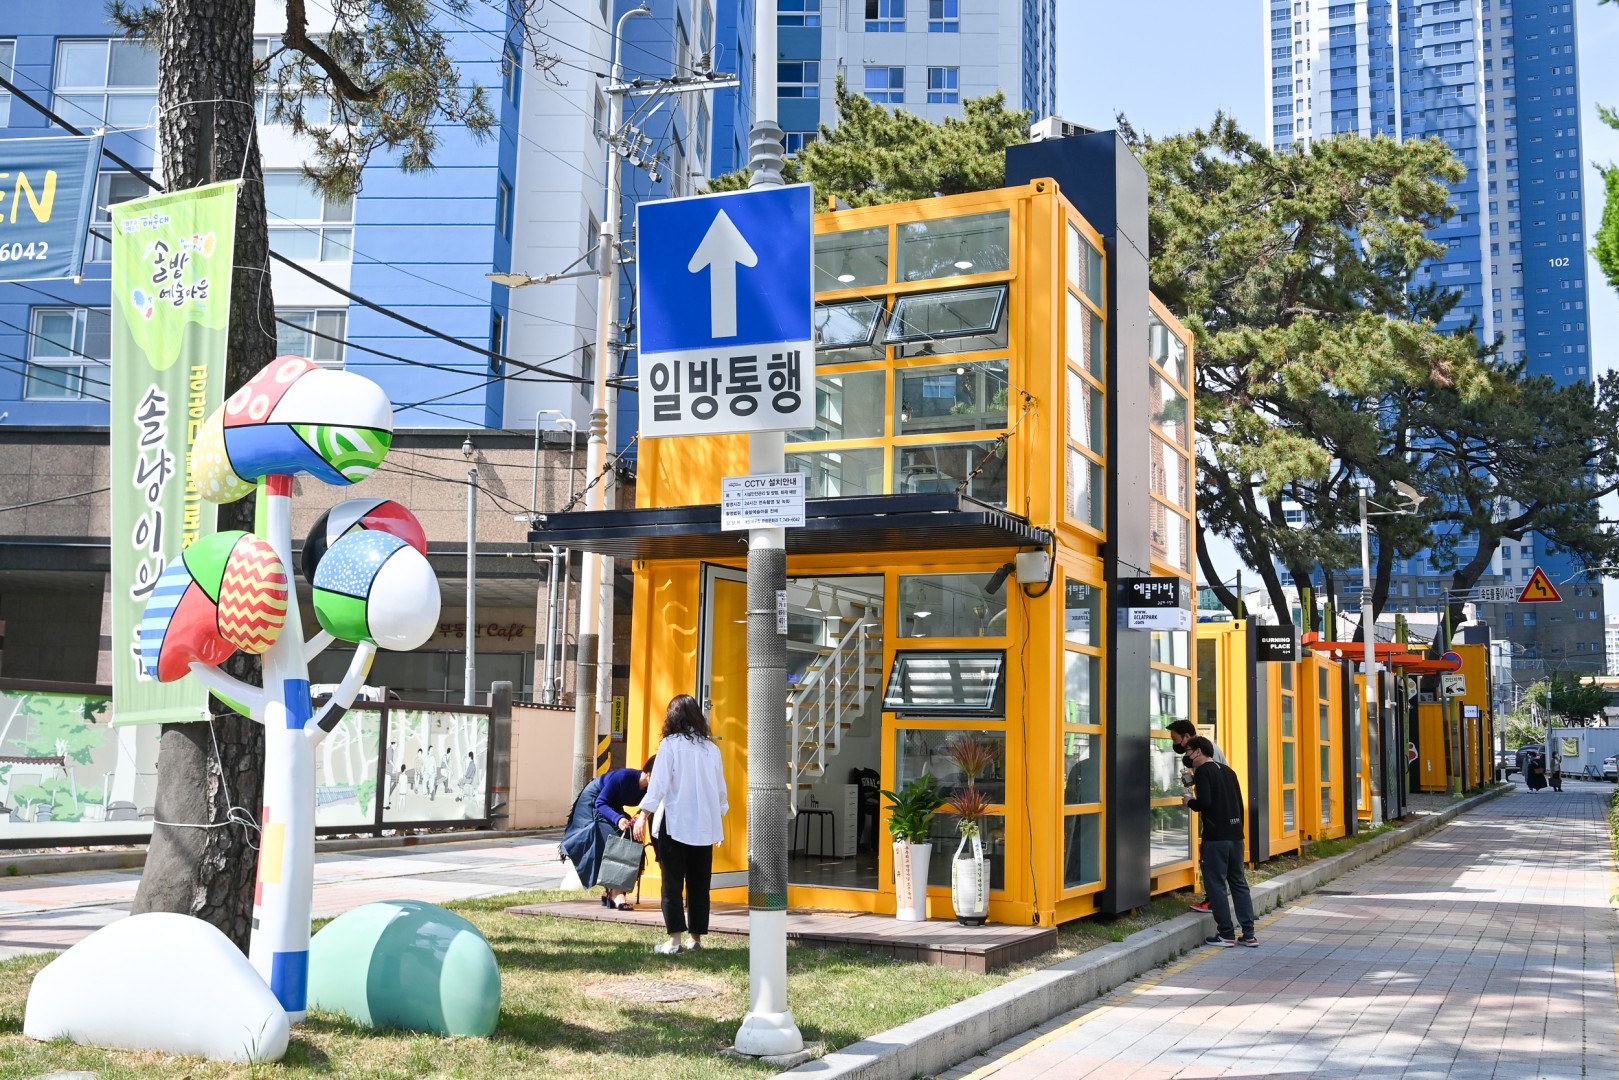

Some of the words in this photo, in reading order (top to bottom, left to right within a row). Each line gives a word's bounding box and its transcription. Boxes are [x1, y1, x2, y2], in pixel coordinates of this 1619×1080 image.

[140, 214, 169, 229] 해운대
[151, 240, 189, 283] 솔밭
[1549, 257, 1569, 267] 102
[159, 279, 208, 307] 예술마을
[650, 351, 801, 421] 일방통행
[744, 480, 766, 488] CCTV
[768, 477, 797, 487] 설치안내
[1133, 582, 1175, 600] 에클라박
[487, 622, 525, 642] Café
